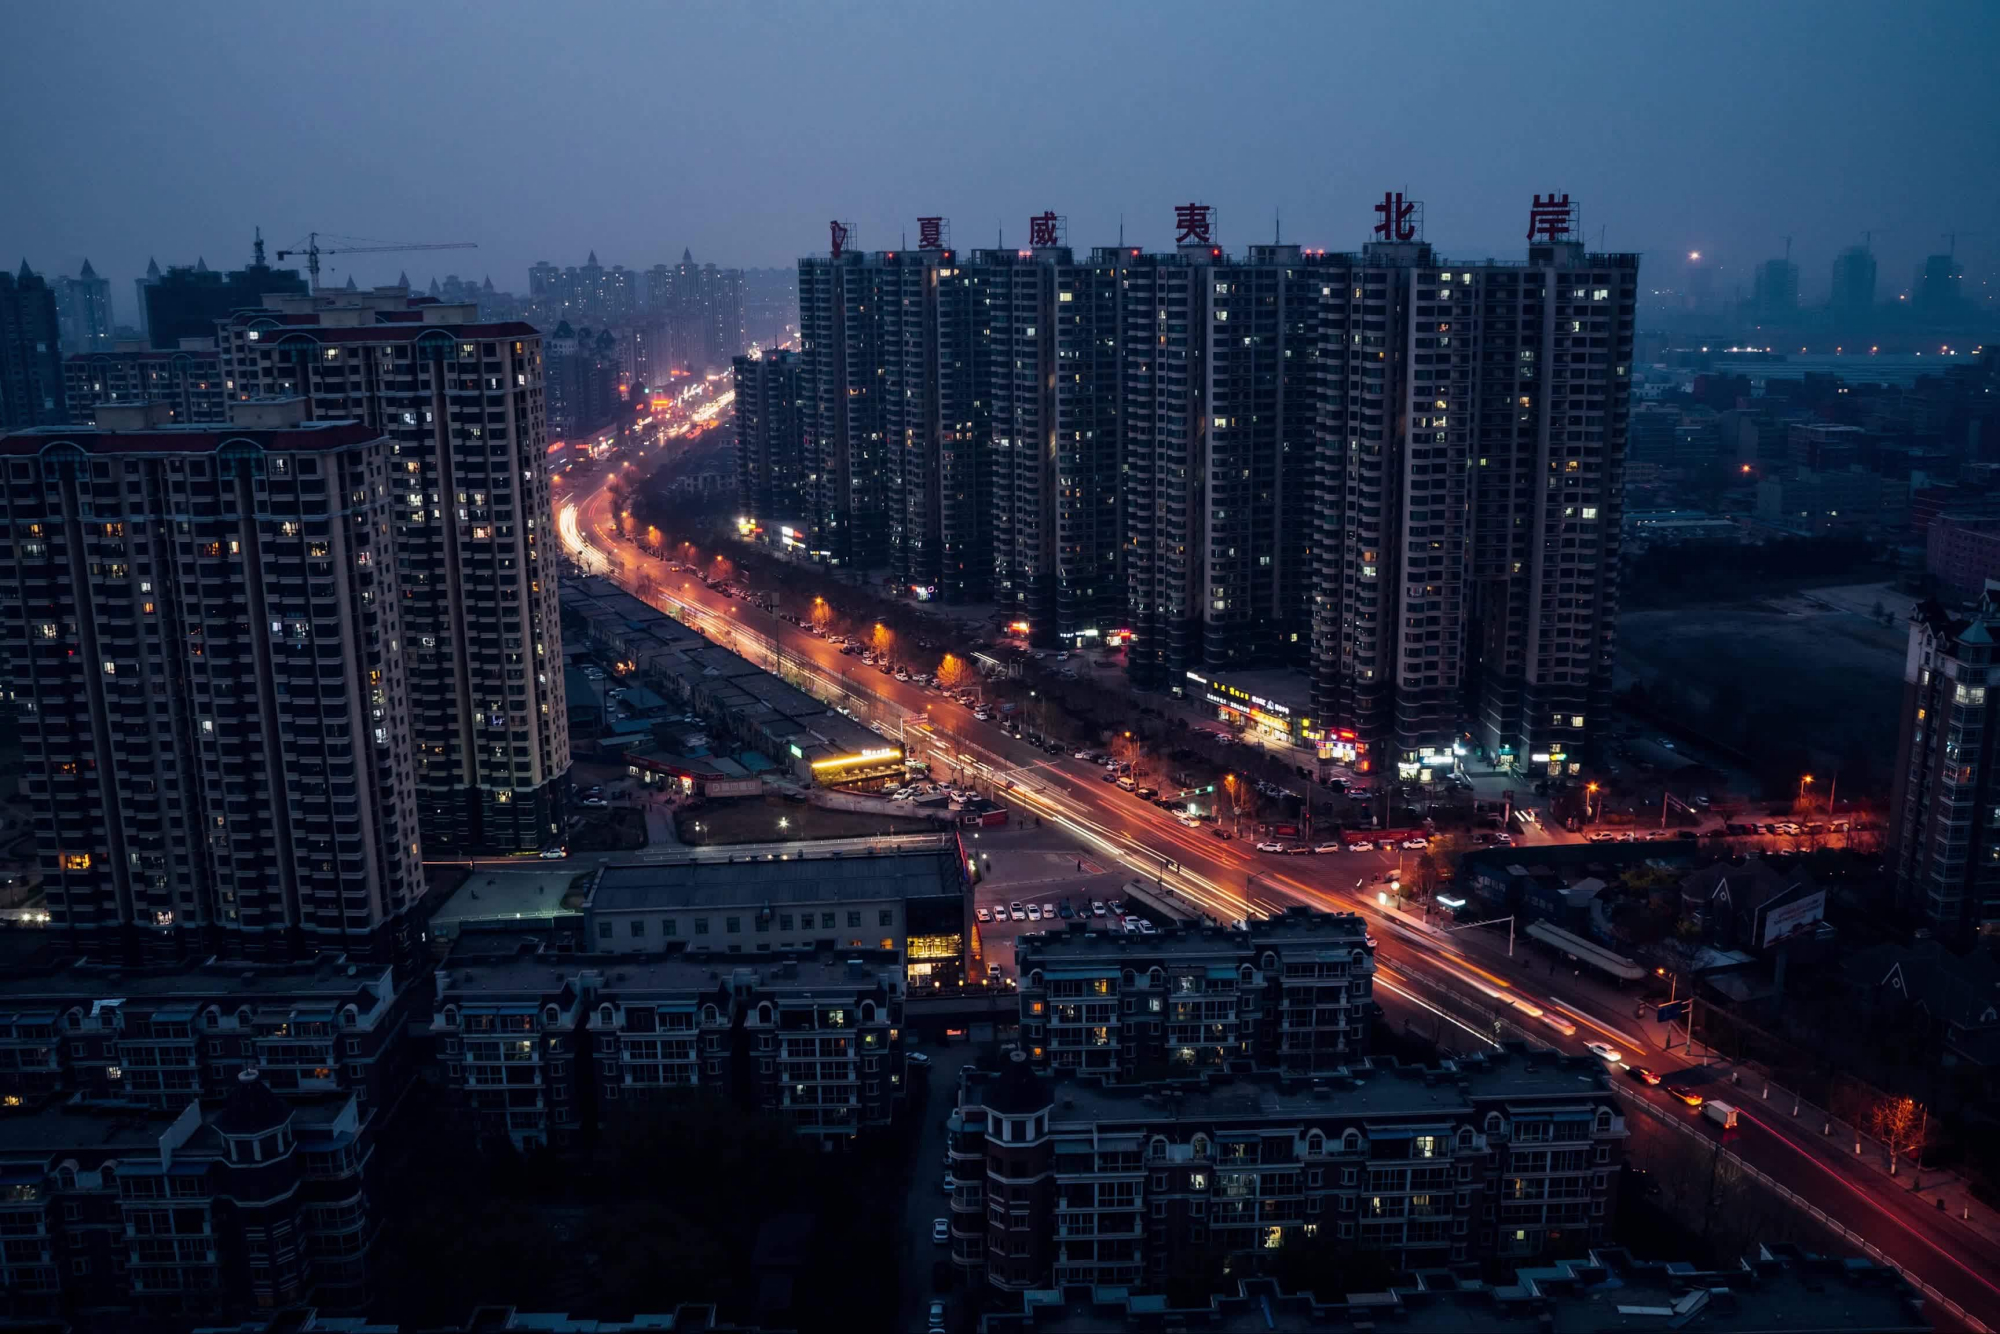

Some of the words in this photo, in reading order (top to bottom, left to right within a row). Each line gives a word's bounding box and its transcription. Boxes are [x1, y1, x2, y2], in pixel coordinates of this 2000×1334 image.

[917, 192, 1571, 249] 夏威夷北岸
